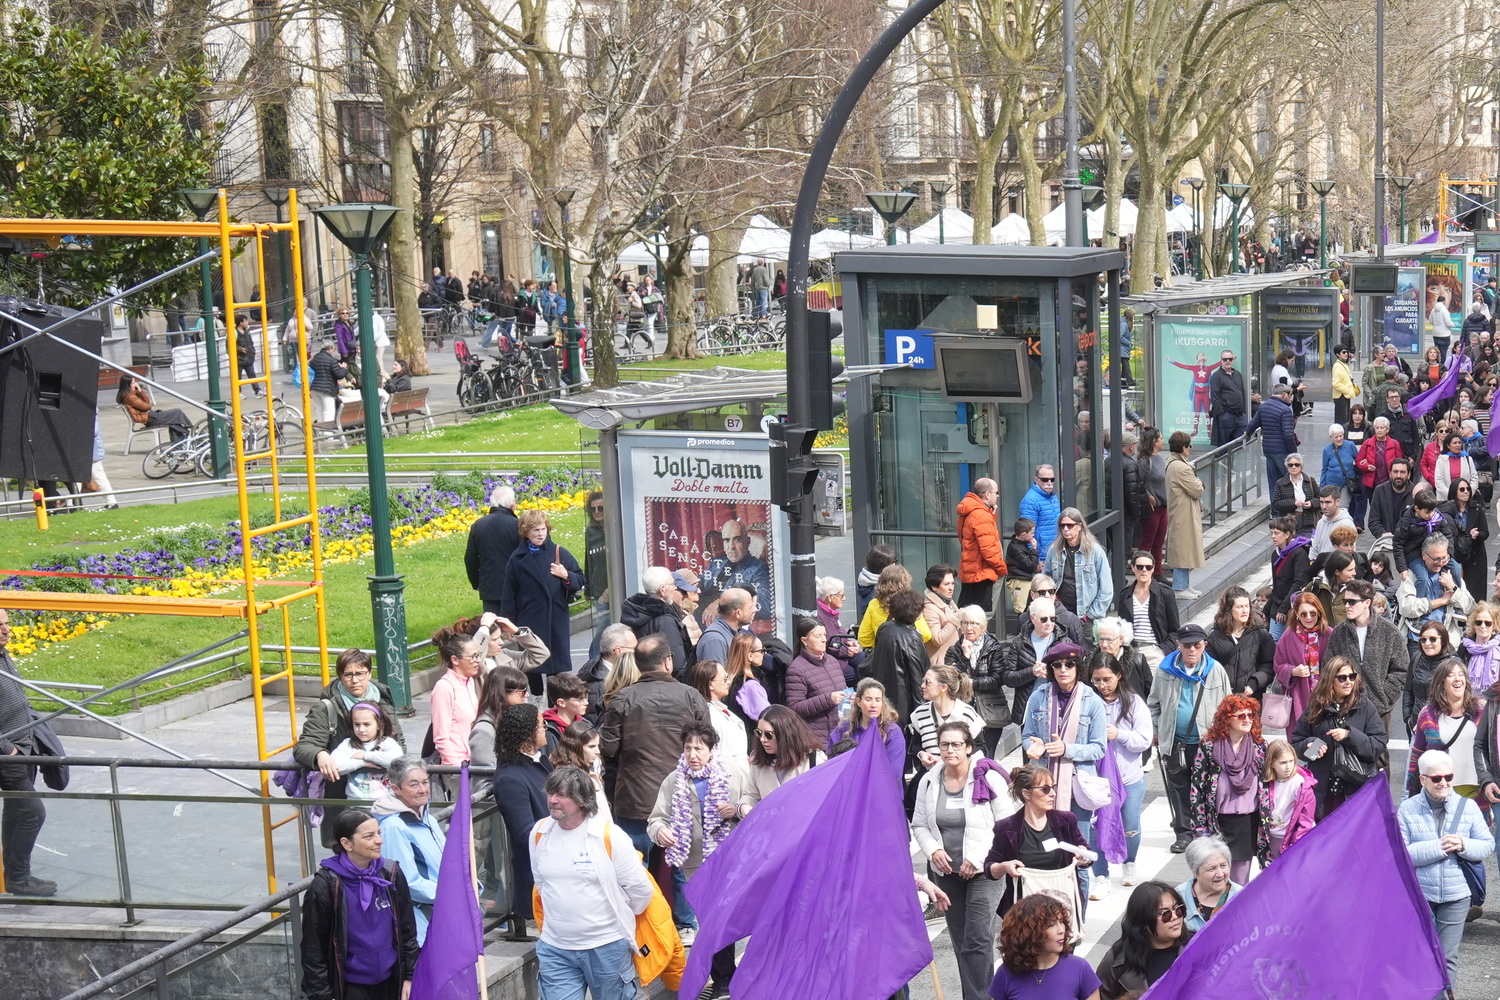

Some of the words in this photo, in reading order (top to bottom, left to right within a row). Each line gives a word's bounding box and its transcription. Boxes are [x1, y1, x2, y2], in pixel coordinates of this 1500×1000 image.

[1175, 337, 1228, 347] IKUSGARRI
[896, 336, 916, 363] P
[908, 356, 925, 365] 24h
[727, 419, 740, 428] B7
[1175, 417, 1191, 425] 682
[697, 438, 735, 446] promedios
[653, 455, 763, 479] Voll-Damm
[671, 479, 710, 493] Doble
[713, 479, 749, 494] malta
